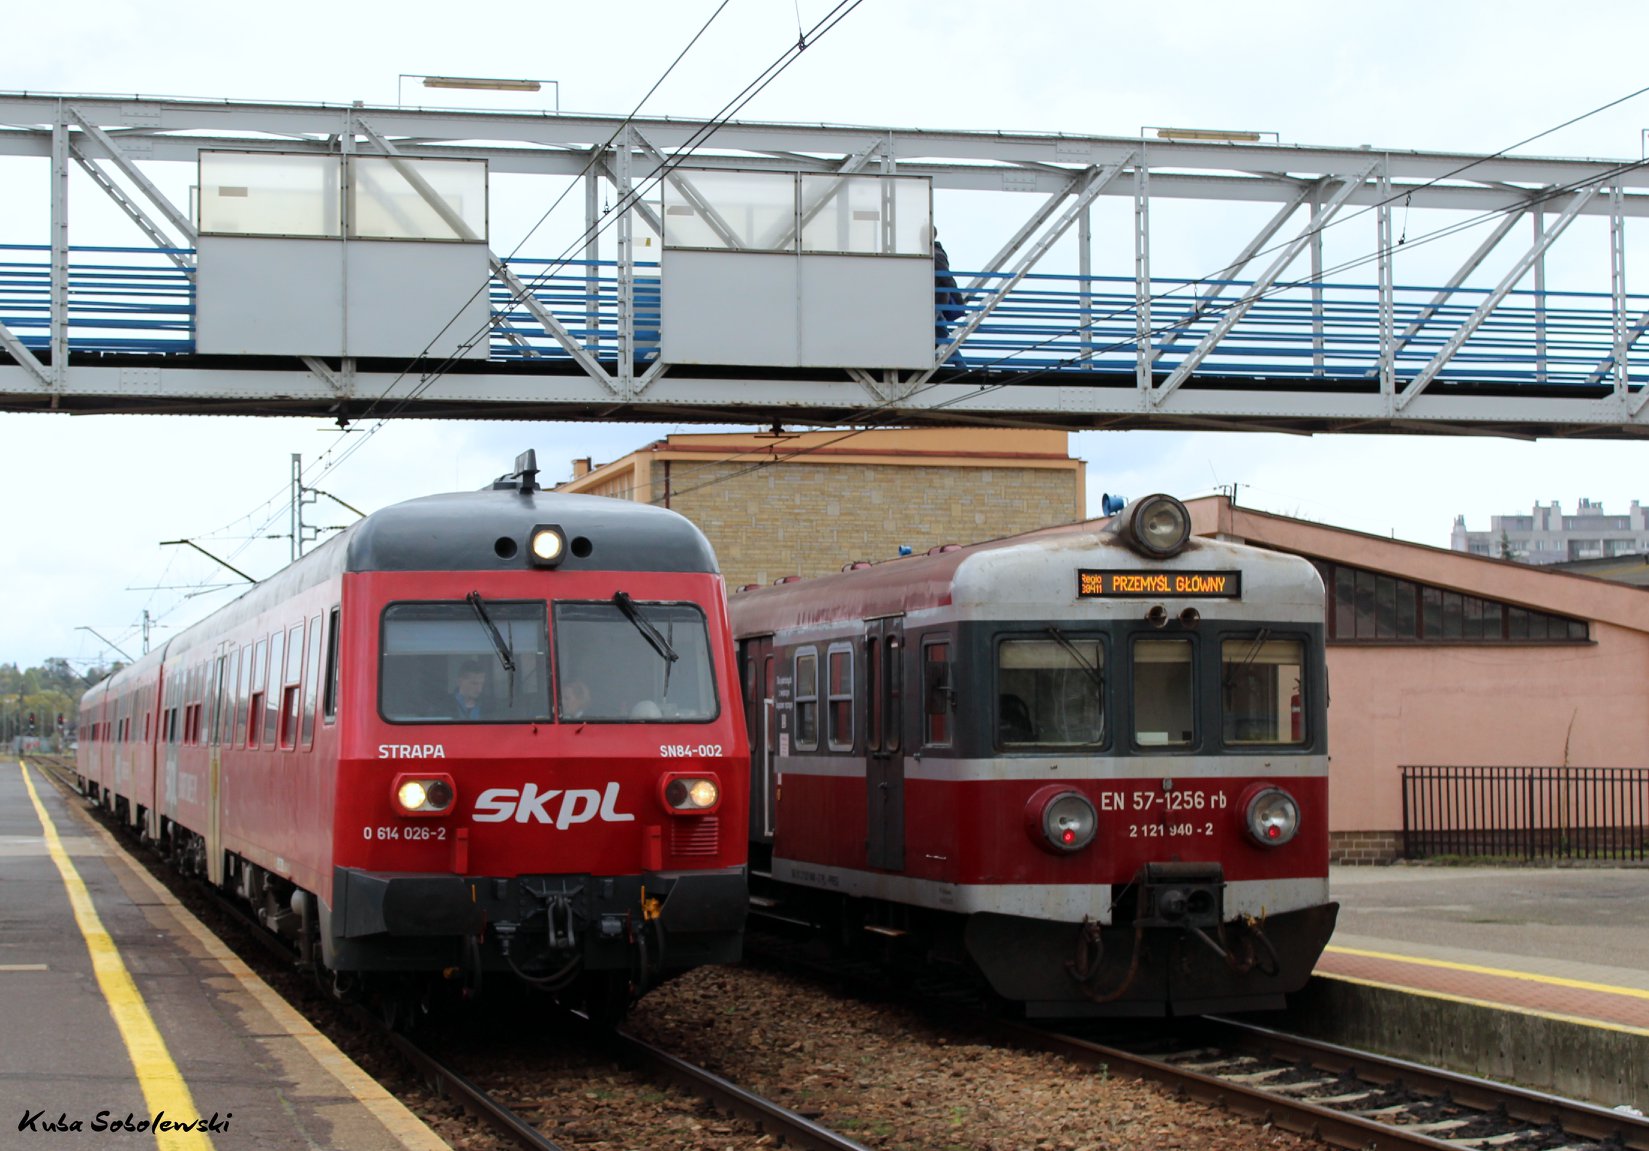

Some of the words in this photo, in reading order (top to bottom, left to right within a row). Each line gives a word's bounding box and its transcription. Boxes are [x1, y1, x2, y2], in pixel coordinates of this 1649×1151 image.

[1112, 574, 1171, 592] PRZEMYŚL
[1176, 574, 1225, 593] GŁÓWNY
[378, 744, 445, 759] STRAPA
[659, 745, 723, 758] SN84-002
[1101, 792, 1125, 811] EN
[1132, 791, 1205, 811] 57-1256
[1210, 790, 1227, 809] rb
[377, 827, 399, 840] 614
[403, 827, 446, 840] 026-2
[1129, 825, 1138, 838] 2
[1141, 824, 1165, 837] 121
[1204, 822, 1214, 836] 2
